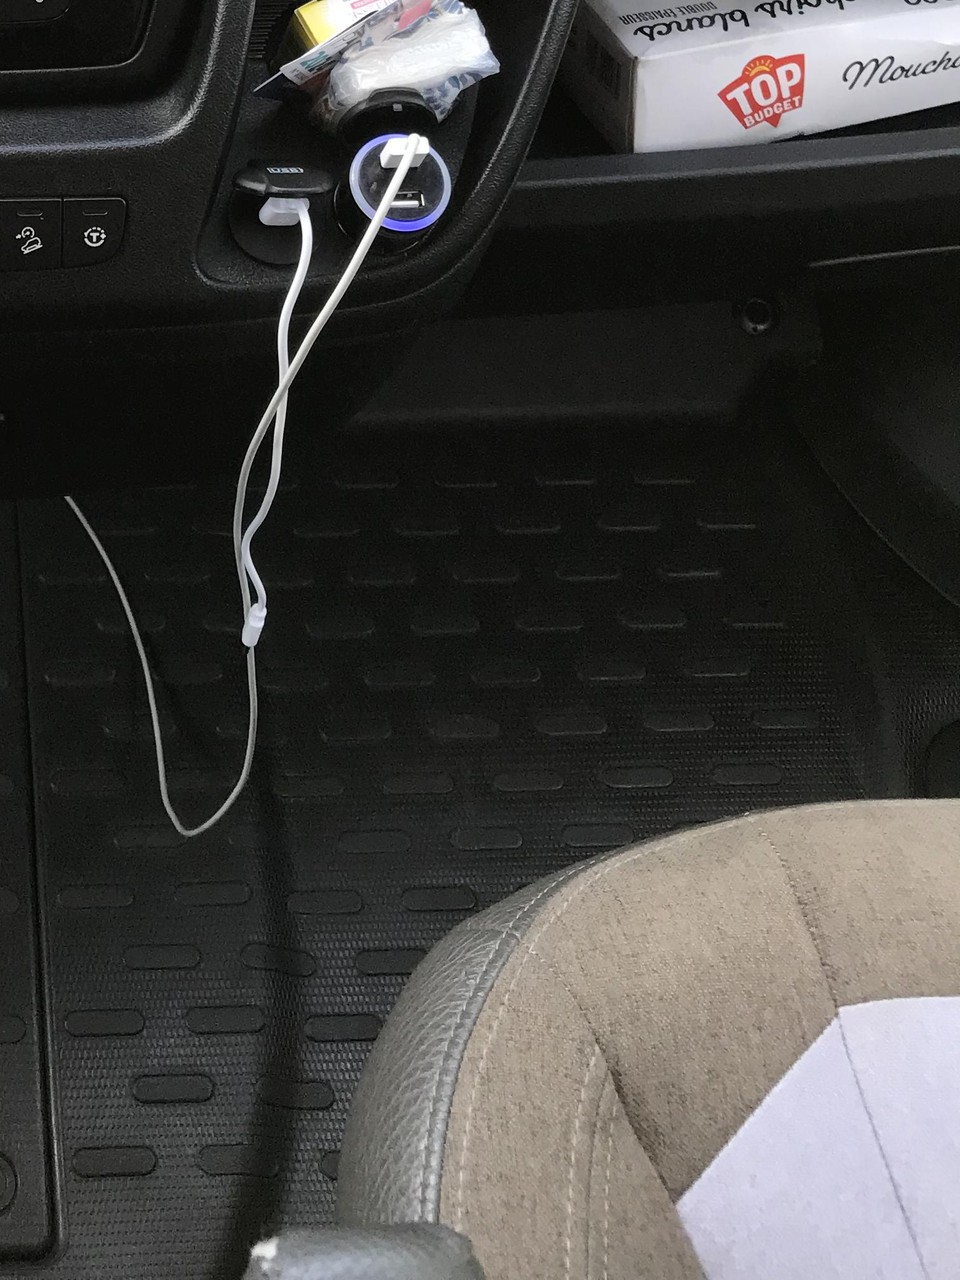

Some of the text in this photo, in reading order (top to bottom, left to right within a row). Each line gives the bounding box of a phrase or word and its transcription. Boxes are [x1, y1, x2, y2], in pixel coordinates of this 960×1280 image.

[619, 1, 718, 25] DOUBLE ÉPAISSEUR
[633, 9, 750, 41] blancs
[726, 62, 802, 116] TOP
[743, 96, 801, 127] BUDGET
